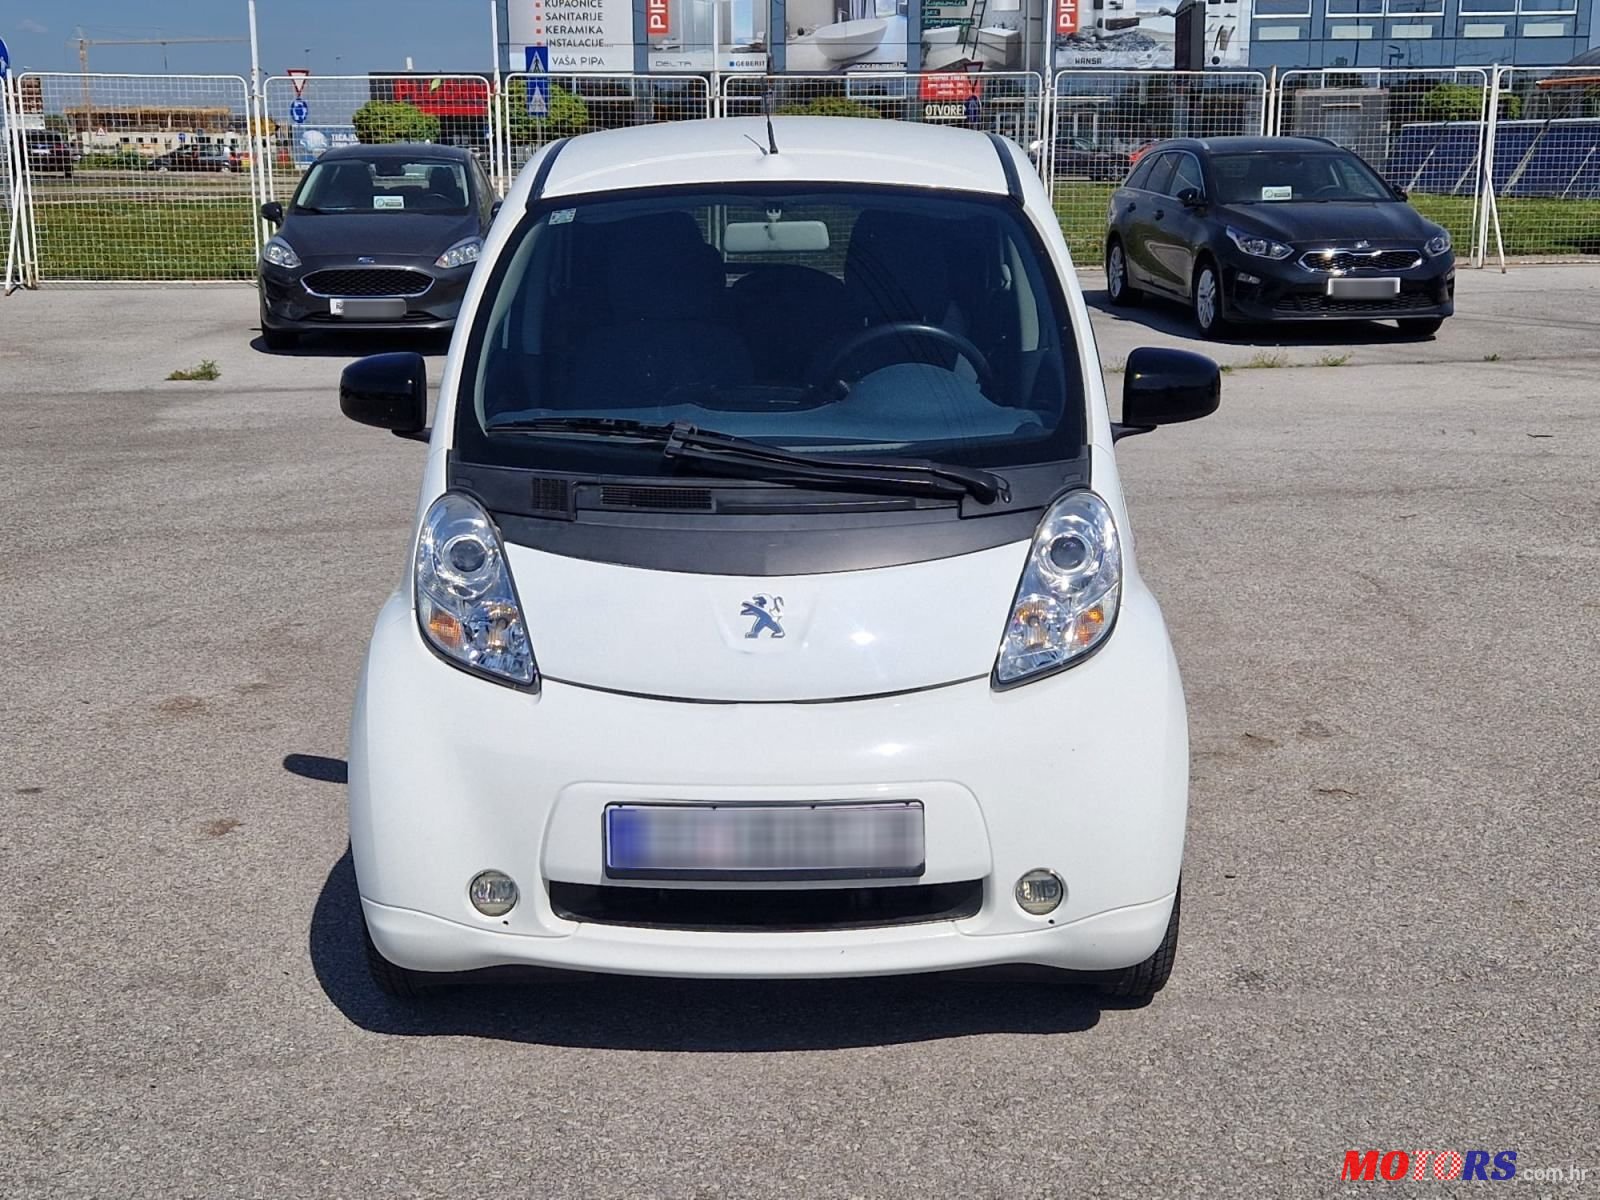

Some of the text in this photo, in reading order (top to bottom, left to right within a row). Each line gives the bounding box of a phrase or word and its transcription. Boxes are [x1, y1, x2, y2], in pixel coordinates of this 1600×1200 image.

[545, 0, 603, 8] KUPAONICE
[545, 12, 604, 21] SANITARIJE
[545, 25, 604, 34] KERAMIKA
[552, 55, 605, 66] VAŠA PIPA
[1075, 57, 1103, 65] HANSA
